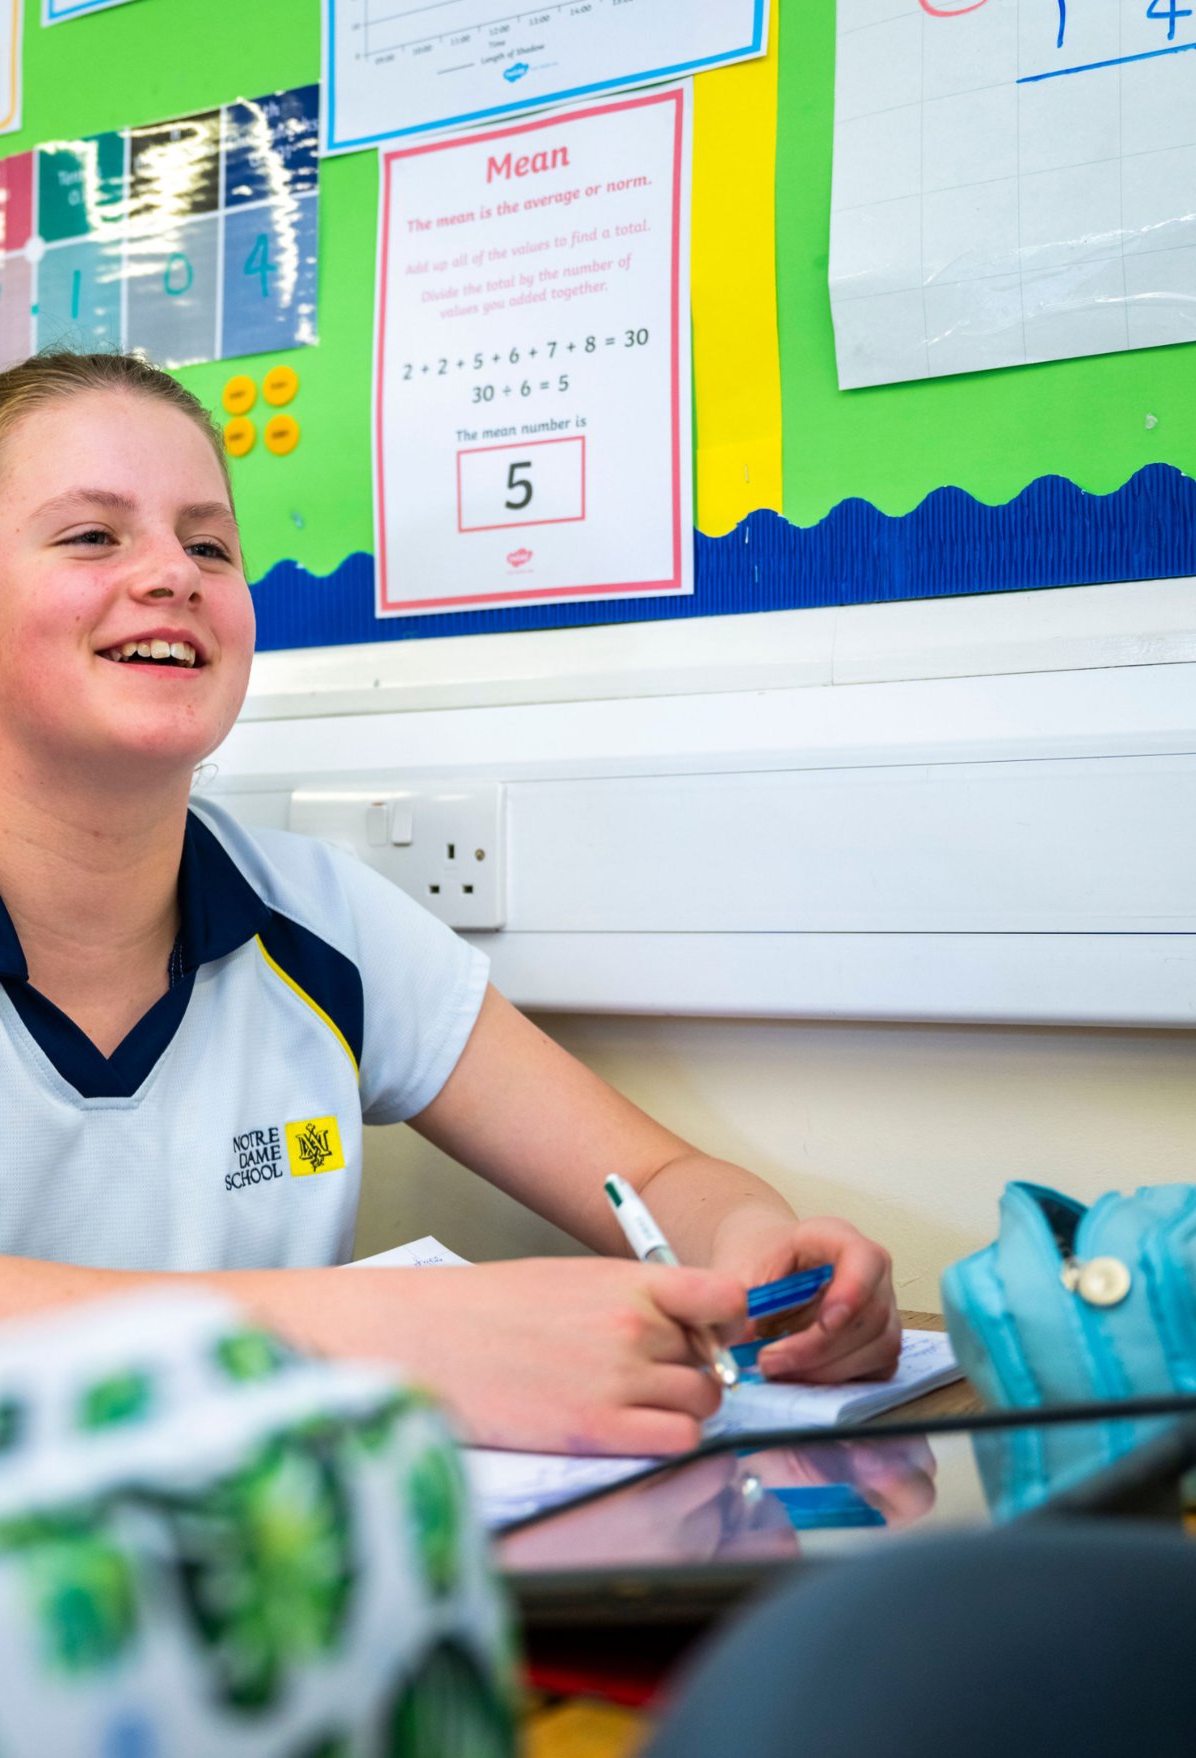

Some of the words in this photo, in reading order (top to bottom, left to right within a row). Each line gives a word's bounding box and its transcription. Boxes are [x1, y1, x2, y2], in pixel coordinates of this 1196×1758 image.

[480, 53, 505, 65] Length
[507, 49, 515, 60] of
[516, 44, 545, 55] Shadow
[486, 146, 571, 184] Mean
[406, 219, 432, 234] The
[436, 211, 476, 228] mean
[480, 205, 493, 221] is
[497, 201, 519, 217] the
[523, 188, 581, 212] average
[584, 184, 602, 198] or
[606, 174, 653, 194] norm.
[405, 260, 429, 276] Add
[432, 259, 448, 274] up
[452, 252, 469, 269] all
[471, 249, 486, 268] of
[488, 245, 508, 262] the
[511, 239, 551, 258] values
[554, 236, 567, 249] to
[570, 228, 598, 249] find
[602, 228, 611, 240] a
[615, 219, 652, 237] total.
[71, 269, 82, 320] 1
[164, 252, 194, 296] 0
[243, 233, 278, 298] 4
[421, 287, 459, 304] Divide
[463, 281, 483, 298] the
[486, 275, 516, 292] total
[519, 271, 535, 288] by
[538, 267, 559, 283] the
[563, 258, 615, 278] number
[618, 252, 633, 271] of
[440, 303, 480, 320] values
[482, 297, 505, 316] you
[509, 289, 548, 308] added
[551, 279, 609, 301] together.
[402, 364, 413, 381] 2
[437, 358, 449, 376] 2
[472, 352, 484, 370] 5
[508, 347, 521, 365] 6
[547, 341, 558, 359] 7
[584, 335, 596, 353] 8
[624, 328, 650, 348] 30
[472, 385, 495, 404] 30
[520, 380, 532, 398] 6
[558, 374, 570, 392] 5
[455, 429, 479, 444] The
[482, 425, 517, 440] mean
[521, 416, 571, 435] number
[575, 415, 587, 428] is
[504, 461, 533, 510] 5
[233, 1126, 280, 1153] NOTRE
[239, 1144, 282, 1169] DAME
[224, 1162, 283, 1191] SCHOOL
